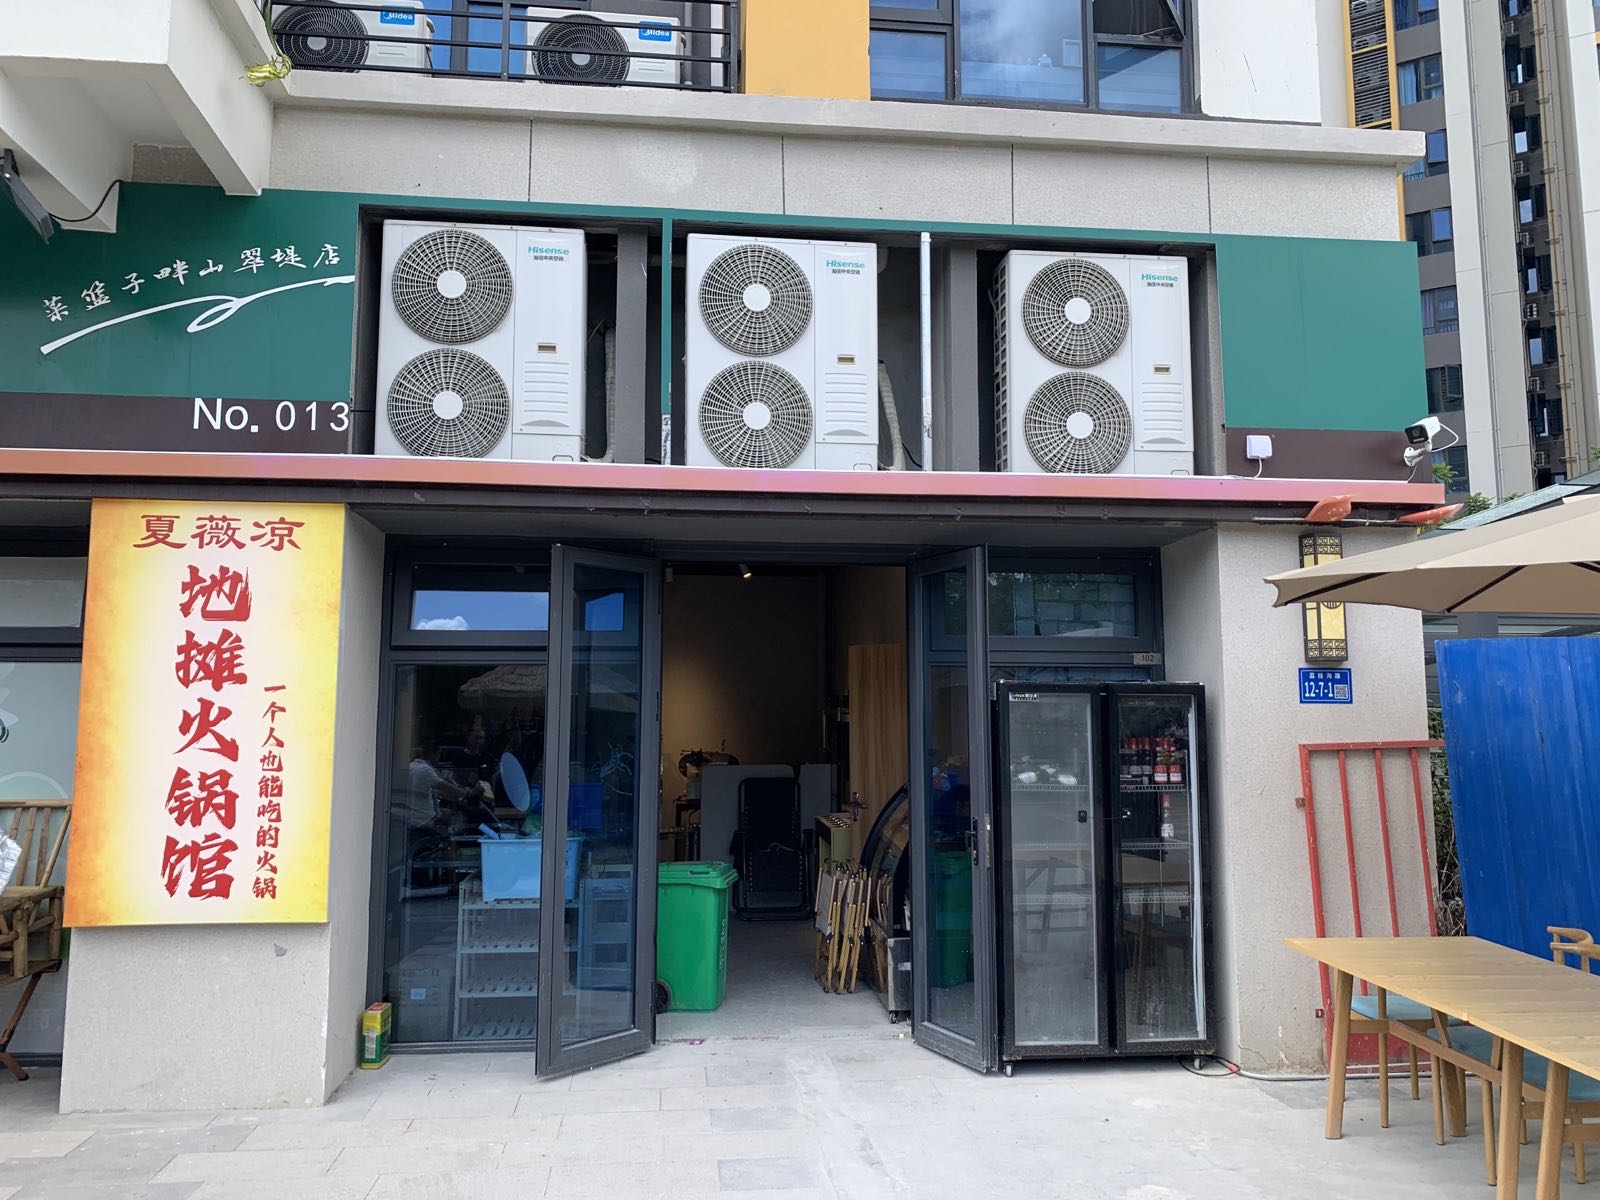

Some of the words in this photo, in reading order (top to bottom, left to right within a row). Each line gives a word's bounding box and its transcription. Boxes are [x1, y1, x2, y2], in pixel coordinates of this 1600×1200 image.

[386, 11, 414, 20] Midea
[644, 28, 670, 37] Midea
[528, 246, 570, 256] Hisense
[826, 260, 866, 269] Hisense
[1141, 273, 1178, 282] Hisense
[192, 397, 259, 433] No.
[275, 400, 349, 432] 013
[132, 514, 305, 552] 夏薇凉
[1304, 681, 1333, 698] 12-7-1
[159, 563, 253, 901] 地摊火锅馆
[252, 684, 286, 900] 一个人也能吃的火锅
